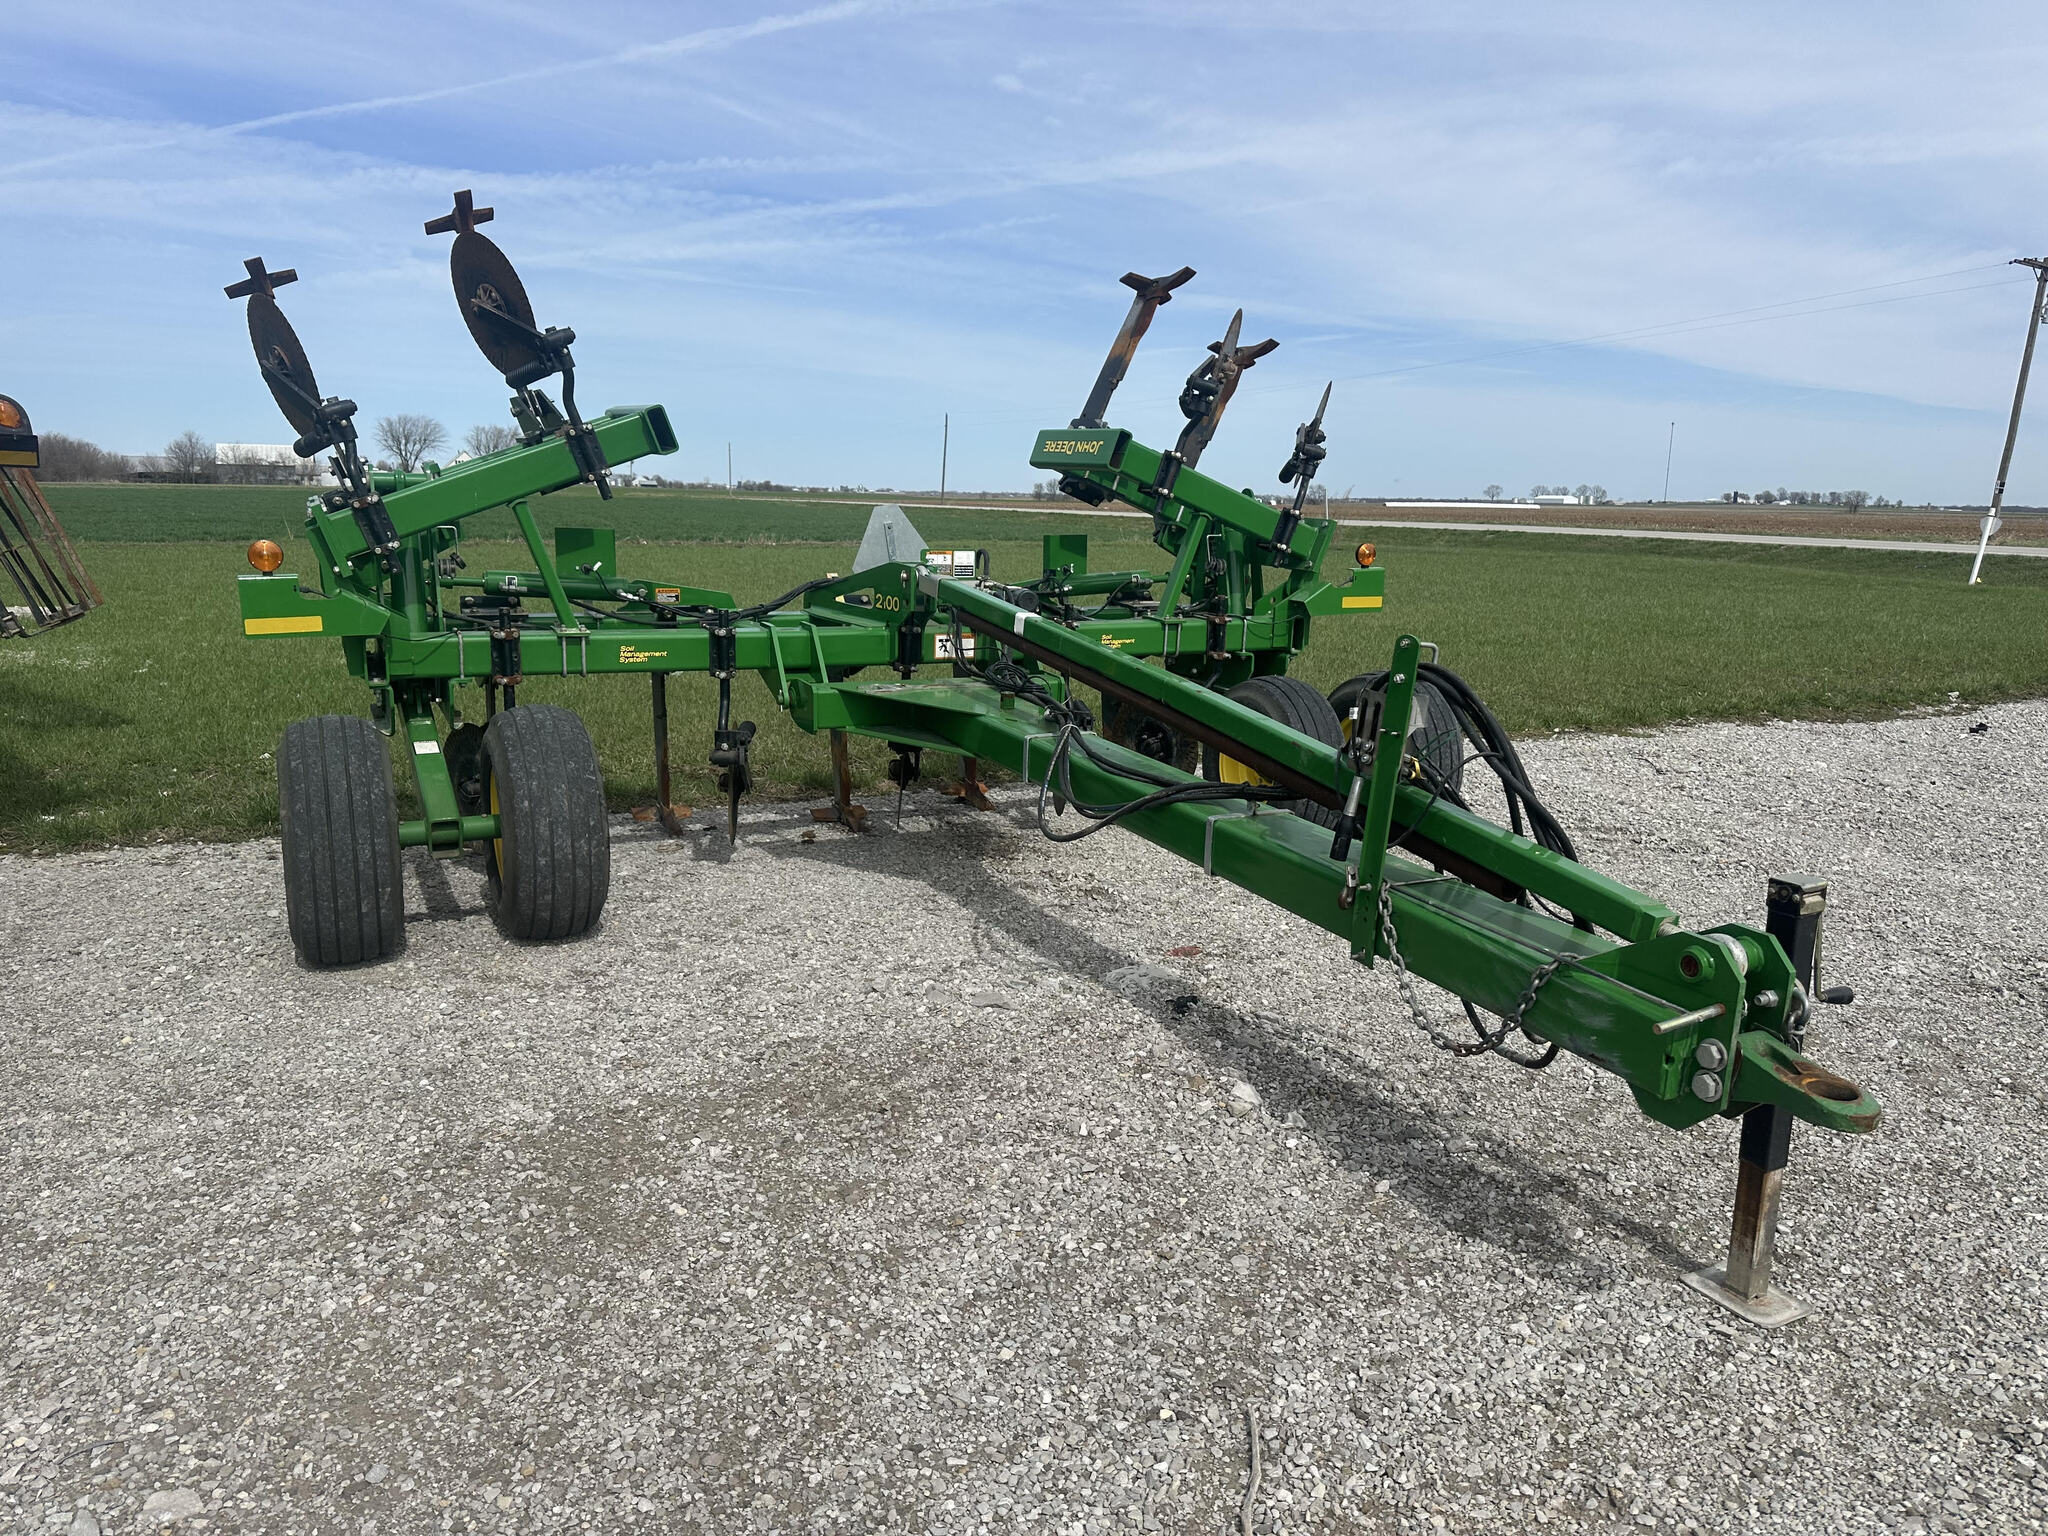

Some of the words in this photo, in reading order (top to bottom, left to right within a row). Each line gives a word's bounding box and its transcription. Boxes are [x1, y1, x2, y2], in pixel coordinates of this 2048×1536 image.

[1043, 440, 1076, 455] DEERE
[1075, 440, 1104, 455] JOHN
[619, 650, 668, 658] Management
[619, 656, 648, 664] System
